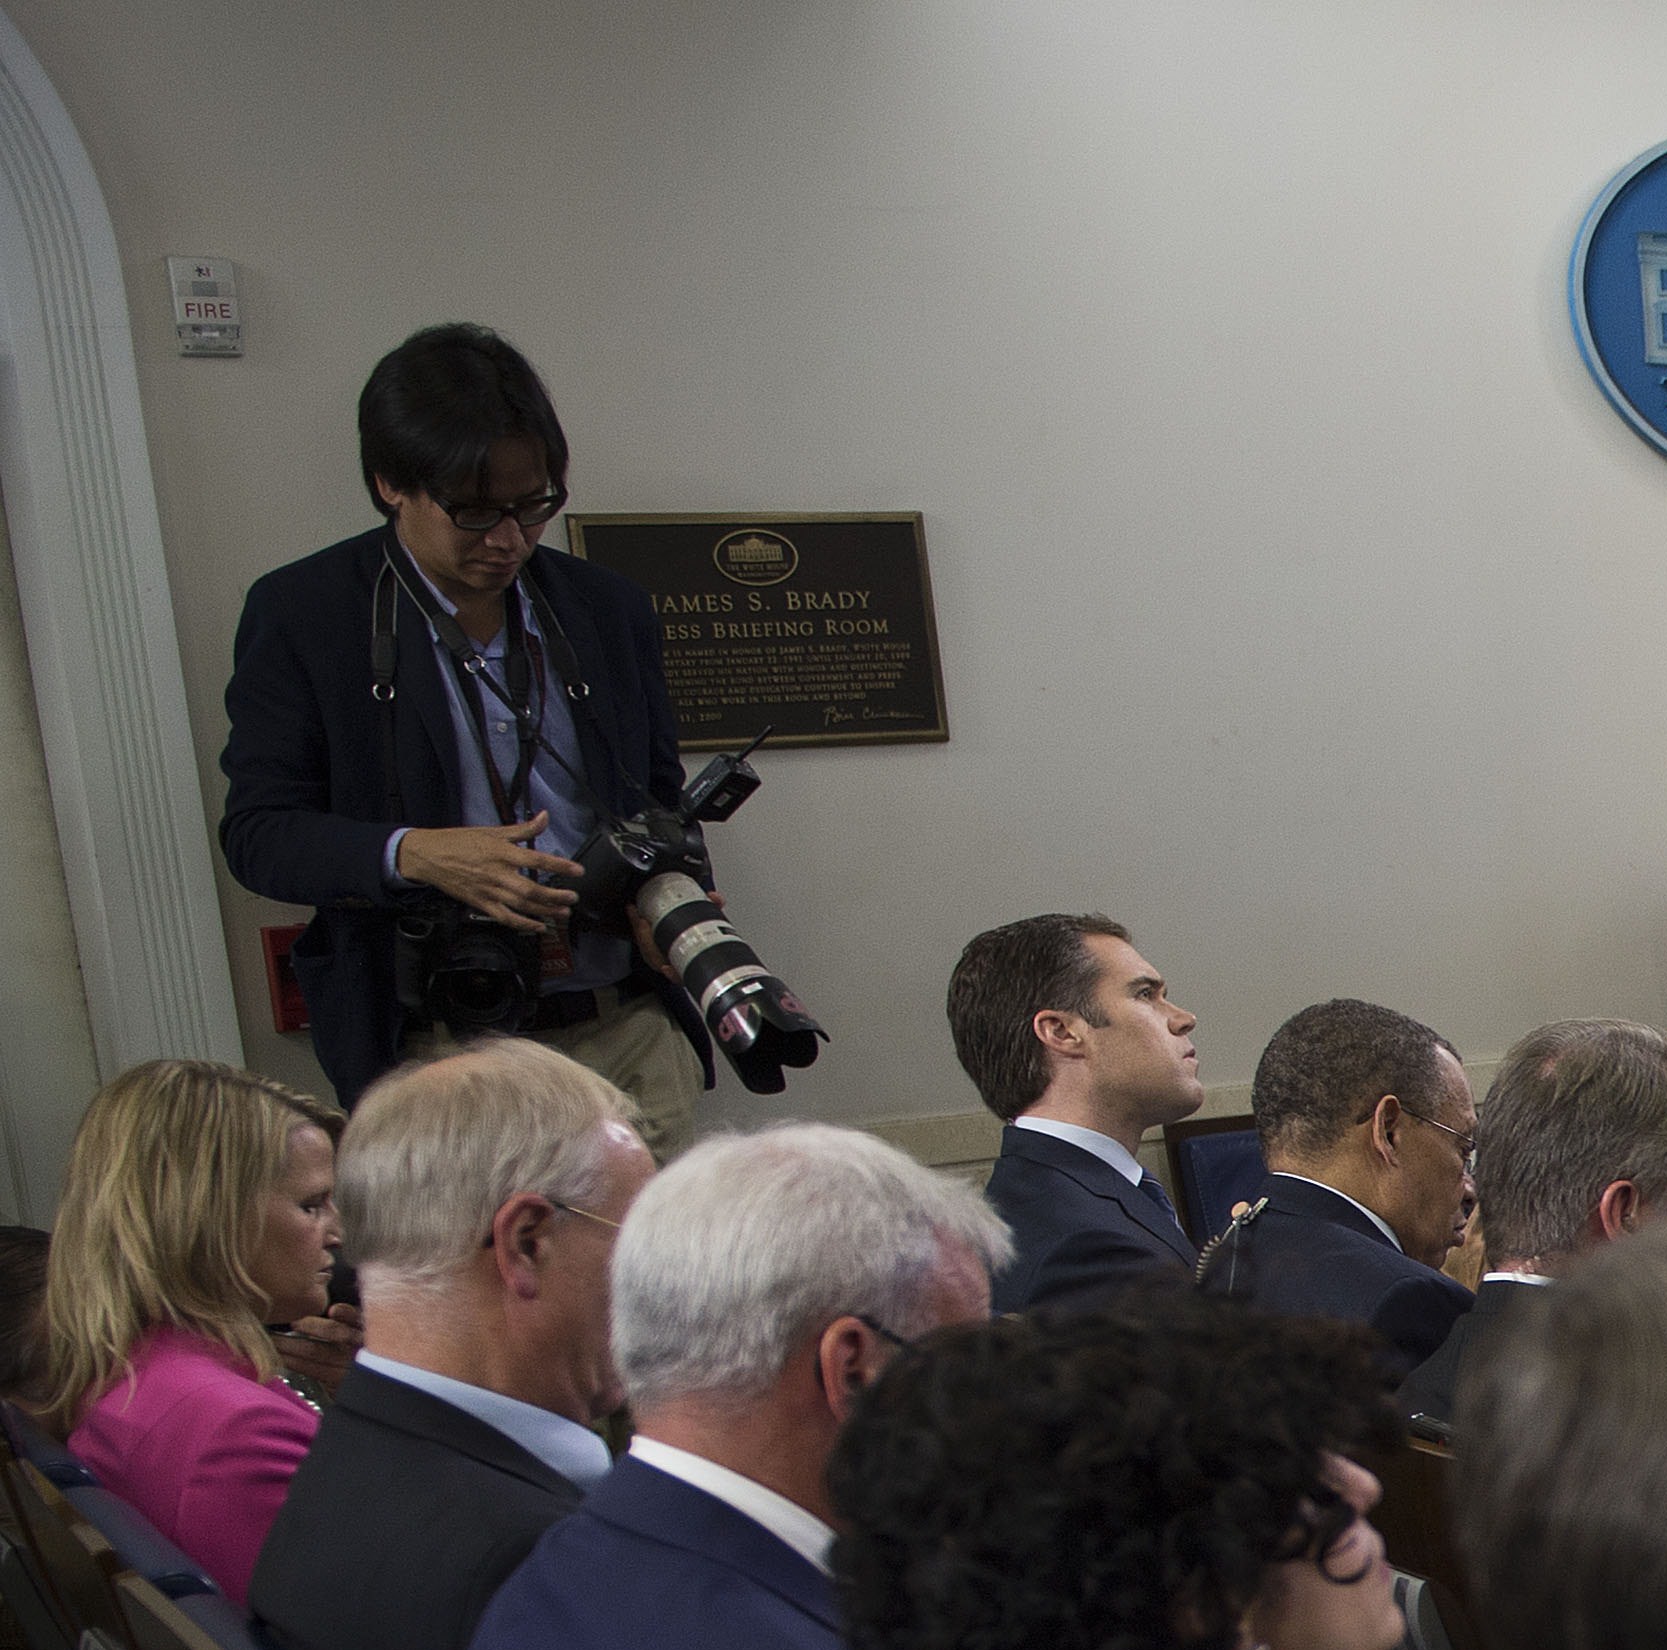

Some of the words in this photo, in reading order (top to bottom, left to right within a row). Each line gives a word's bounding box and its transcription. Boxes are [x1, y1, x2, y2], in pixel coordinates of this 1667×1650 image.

[184, 302, 232, 319] FIRE
[650, 593, 734, 614] JAMES
[747, 591, 771, 612] S.
[785, 590, 871, 611] BRADY
[663, 623, 702, 640] ESS
[712, 619, 814, 640] BRIEFING
[825, 618, 889, 637] ROOM
